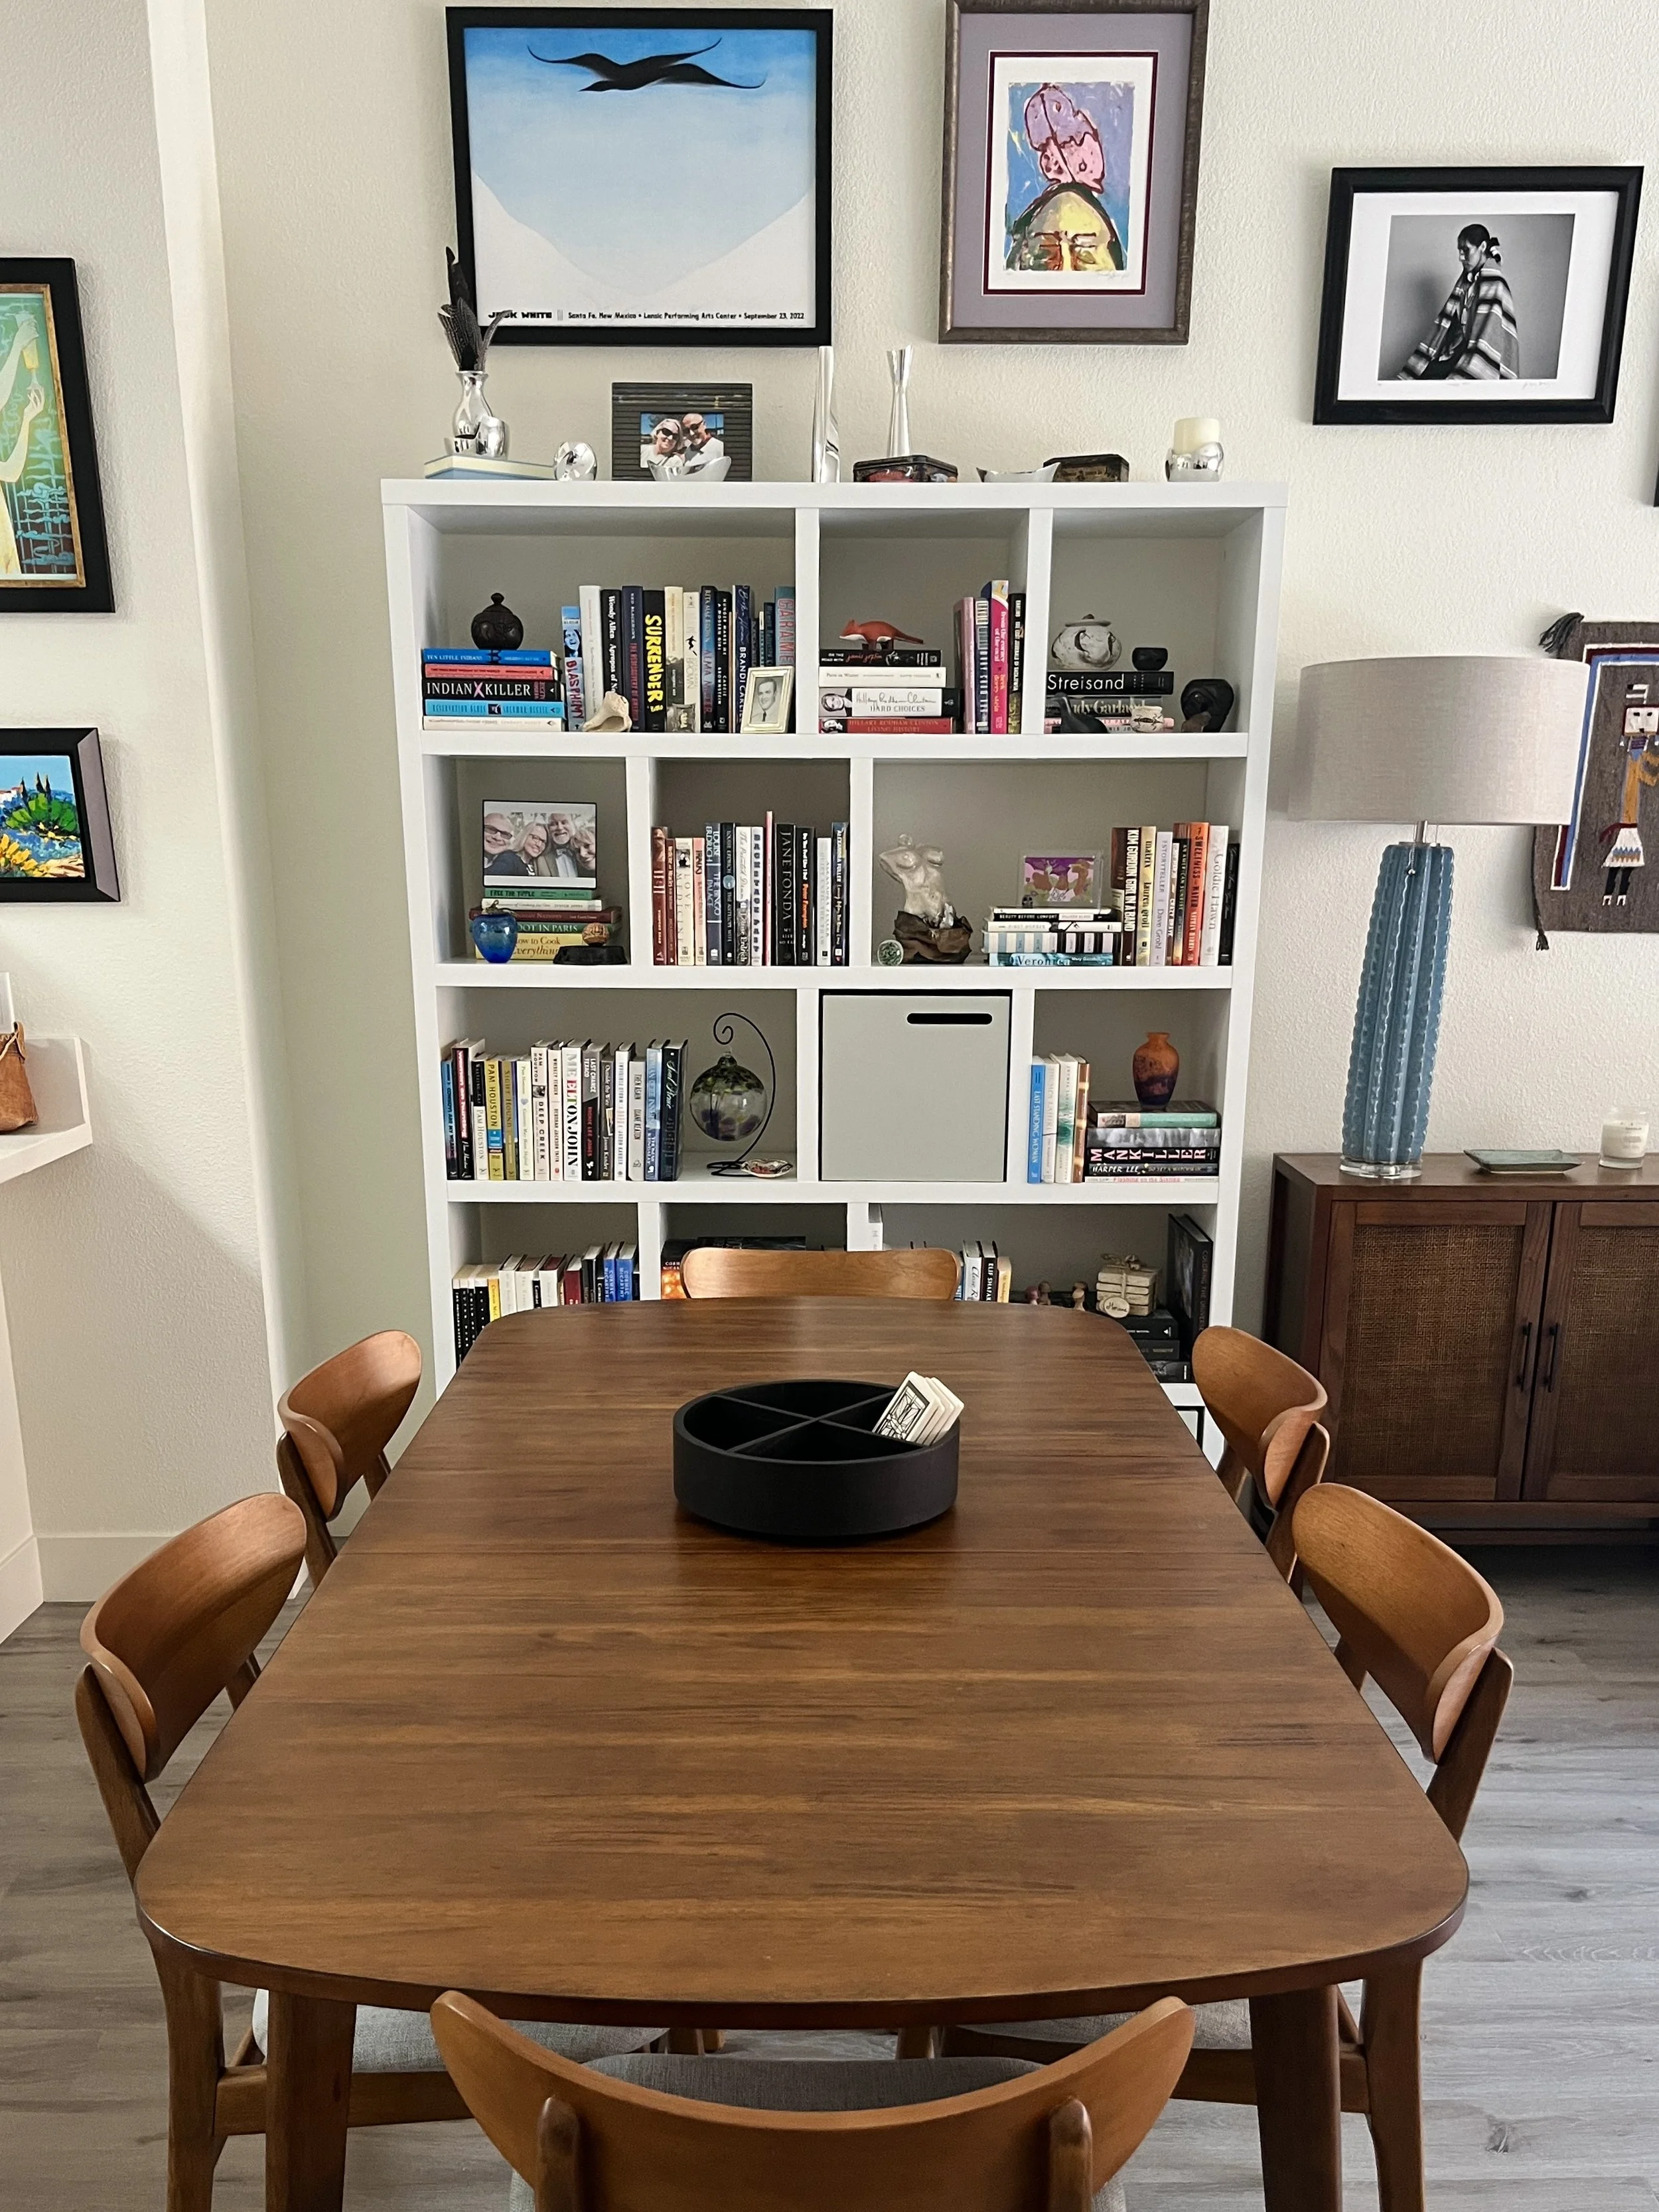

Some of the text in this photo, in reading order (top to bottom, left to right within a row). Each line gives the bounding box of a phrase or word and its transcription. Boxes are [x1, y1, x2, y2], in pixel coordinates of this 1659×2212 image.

[777, 599, 795, 667] CARAME
[644, 615, 664, 703] SURRENDER
[427, 682, 532, 696] INDIAN KILLER
[1047, 674, 1124, 690] Streisand
[1127, 829, 1139, 845] KIM
[1125, 846, 1139, 877] GORDON
[1143, 840, 1153, 869] matrix
[780, 832, 792, 921] JANE FONDA
[1125, 878, 1137, 895] GIRL
[1123, 912, 1135, 932] BAND
[1156, 909, 1165, 928] Dave
[540, 936, 561, 945] Cook
[738, 936, 748, 962] Erdrich
[1016, 955, 1070, 966] Veronica
[489, 1086, 498, 1127] HOUSTON
[567, 1080, 578, 1125] ELTON
[567, 1126, 578, 1167] JOHN
[1092, 1164, 1122, 1173] HARPER
